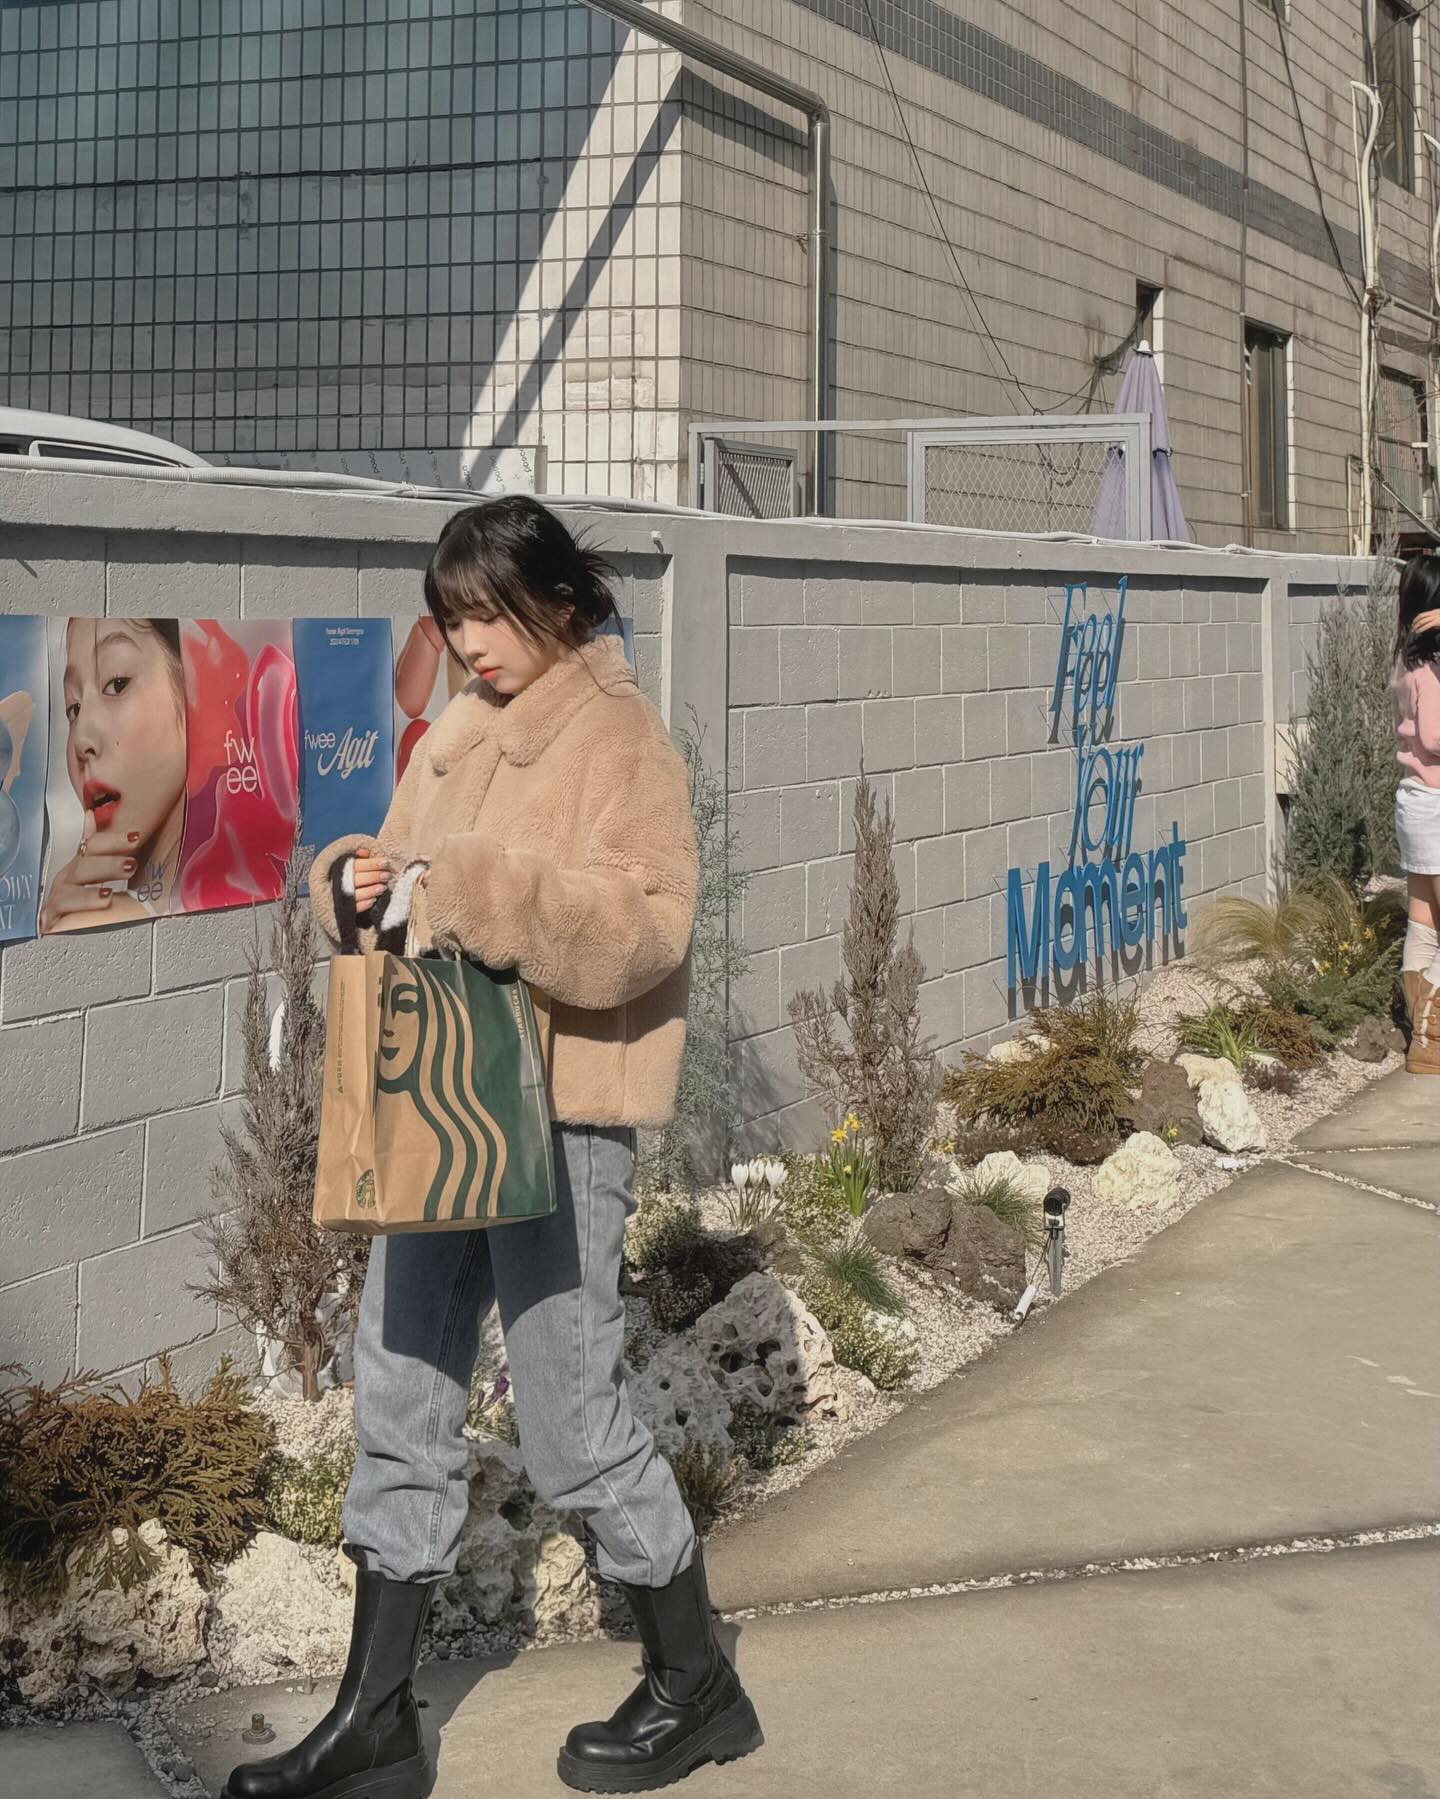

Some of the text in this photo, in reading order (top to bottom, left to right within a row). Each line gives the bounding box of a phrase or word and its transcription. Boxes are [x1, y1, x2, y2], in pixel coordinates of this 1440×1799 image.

[1048, 576, 1128, 713] Feel
[224, 730, 255, 765] fw
[304, 726, 380, 780] fwee Agit
[226, 766, 258, 794] ee
[137, 882, 163, 903] ee
[1007, 821, 1188, 989] Moment
